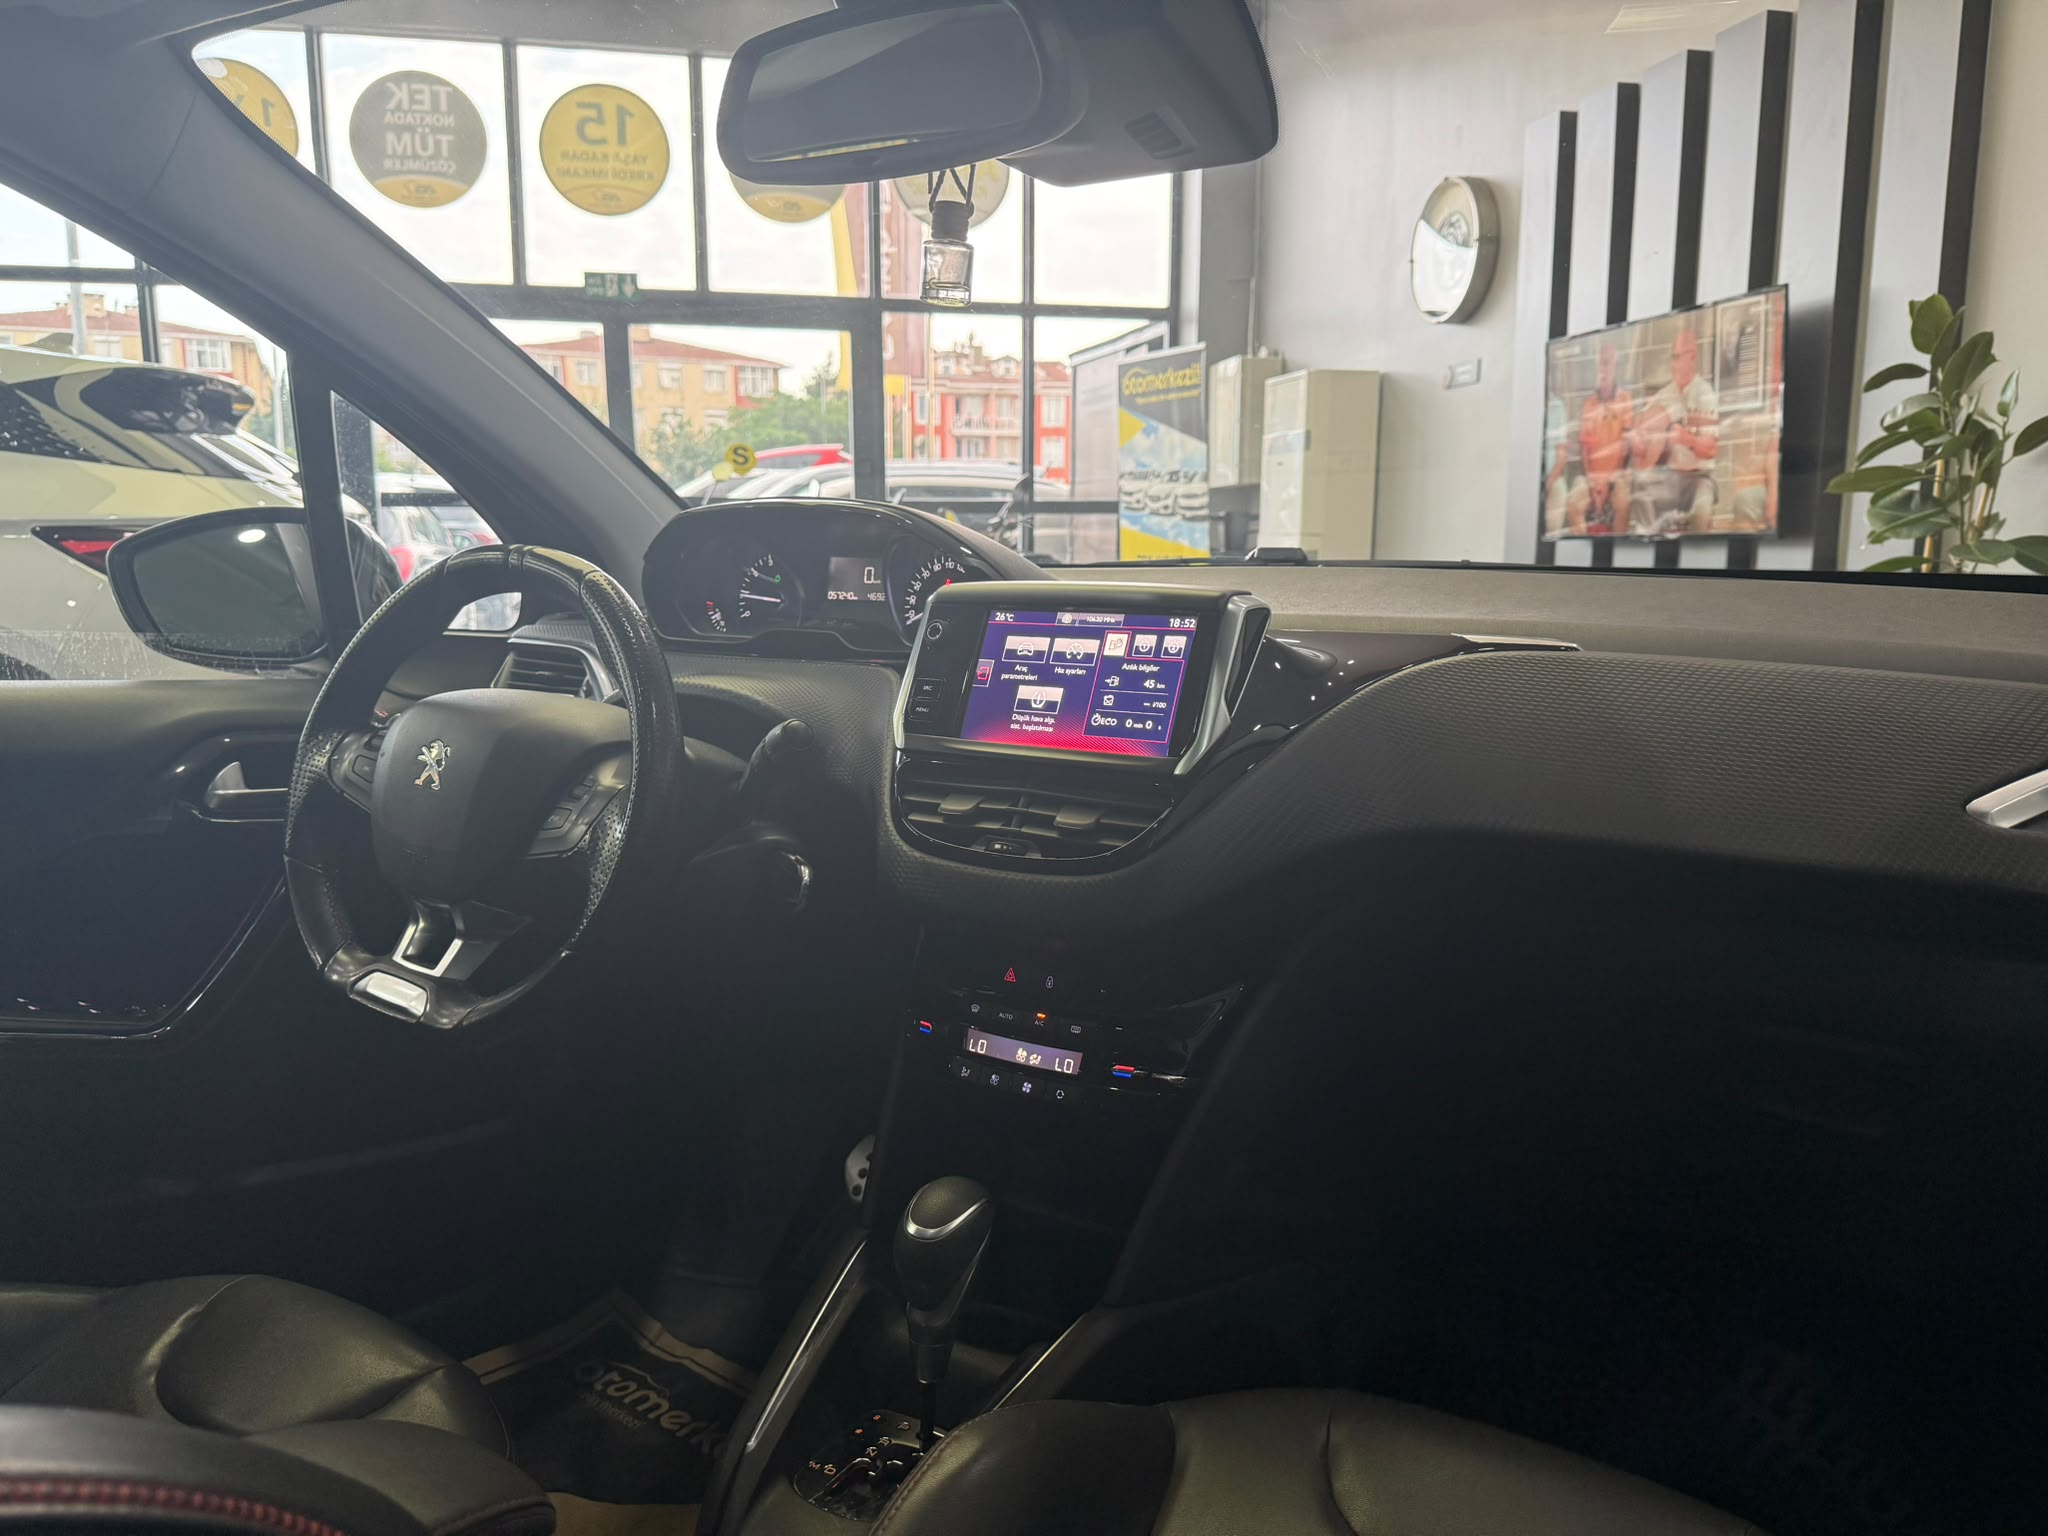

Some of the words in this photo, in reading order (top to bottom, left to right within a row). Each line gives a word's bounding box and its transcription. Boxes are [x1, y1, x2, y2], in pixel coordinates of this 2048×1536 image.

[732, 446, 749, 466] S
[864, 567, 875, 584] 0
[1169, 618, 1196, 628] 18:52
[1138, 664, 1160, 673] bilgiler
[1000, 673, 1038, 681] parametreleri
[1143, 680, 1155, 688] 45
[1030, 714, 1043, 722] hava
[1100, 717, 1117, 726] ECO
[1125, 719, 1133, 728] 0
[1145, 720, 1153, 729] 0
[998, 1012, 1013, 1020] AUTO
[969, 1038, 987, 1054] LO
[1055, 1057, 1074, 1074] LO
